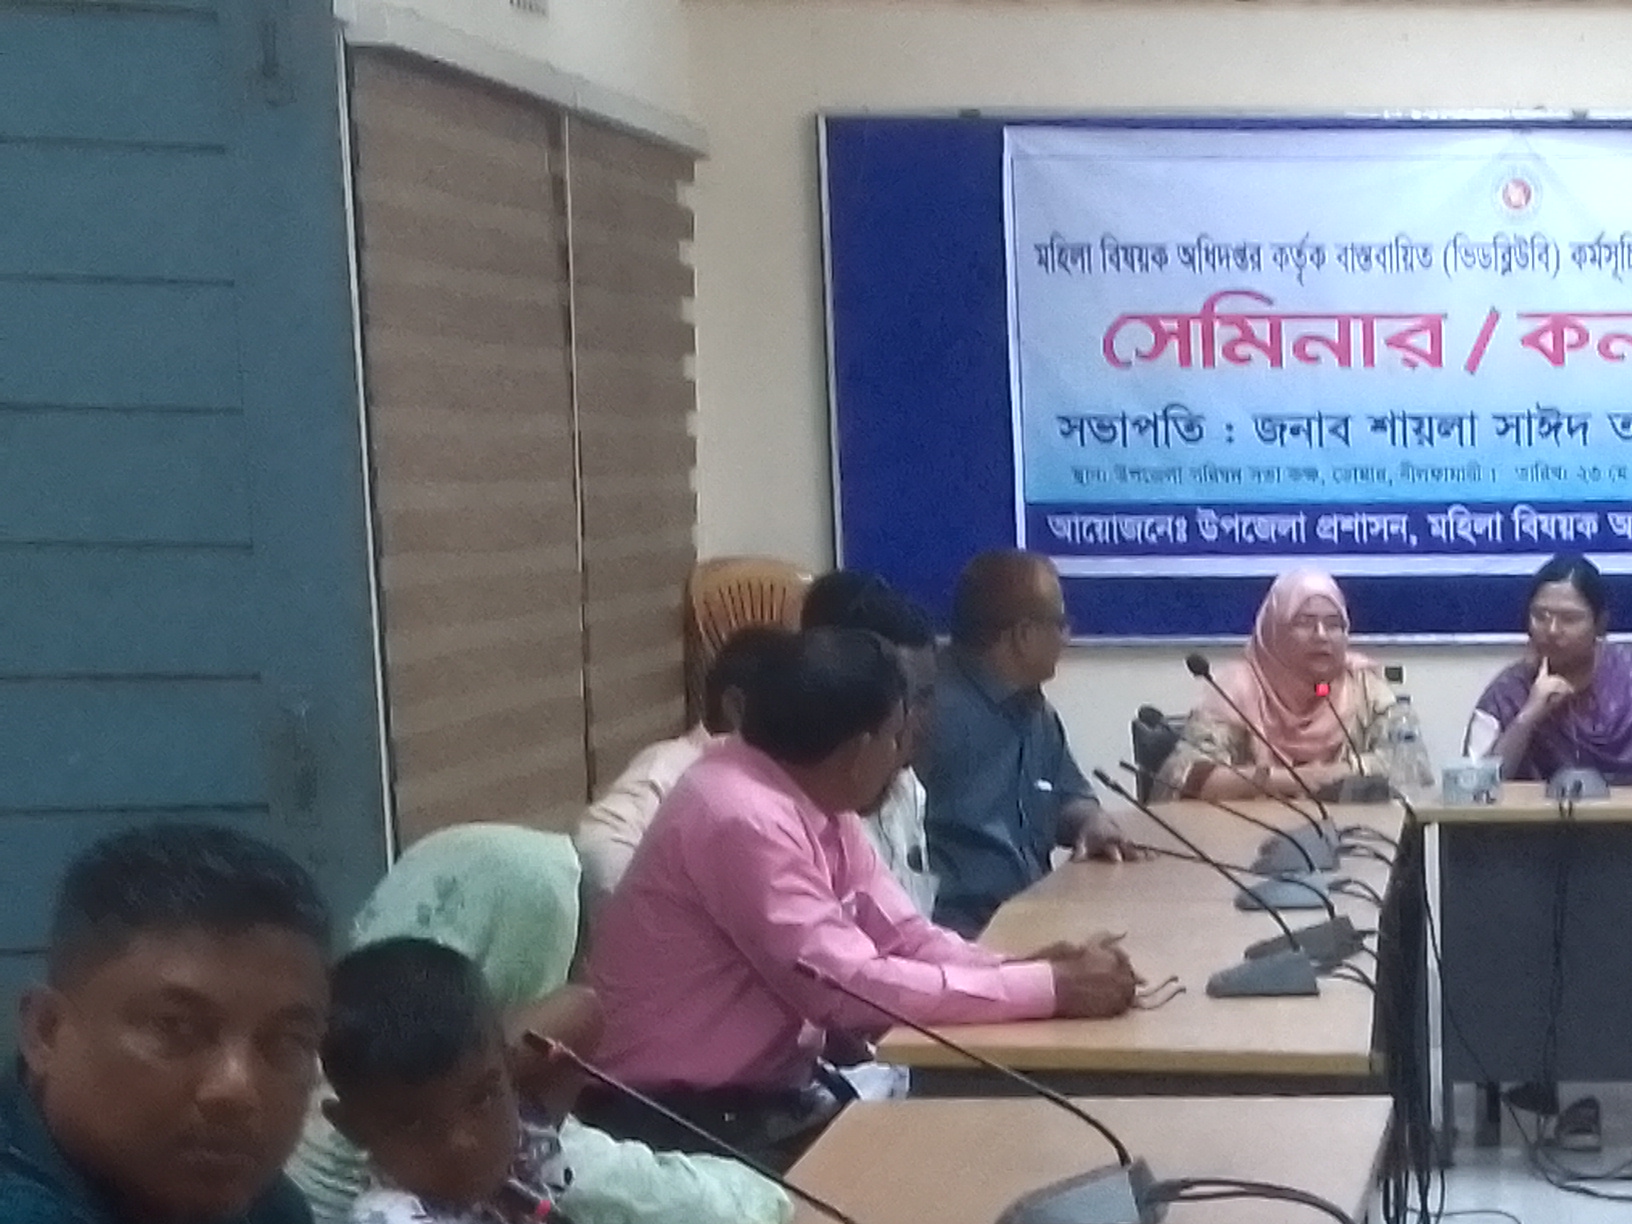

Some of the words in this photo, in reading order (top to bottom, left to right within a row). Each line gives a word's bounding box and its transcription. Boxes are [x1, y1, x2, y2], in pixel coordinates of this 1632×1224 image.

[1034, 230, 1093, 276] মহিলা
[1099, 231, 1170, 274] বিষয়ক
[1177, 231, 1262, 275] অধিদপ্তর
[1269, 230, 1326, 287] কর্তৃক
[1334, 231, 1433, 274] বাস্তবায়িত
[1102, 289, 1449, 369] সেমিনার
[1464, 306, 1502, 375] /
[1057, 403, 1206, 449] সভাপতি
[1251, 409, 1352, 449] জনাব
[1367, 409, 1480, 448] শায়লা
[1492, 402, 1593, 447] সাঈদ
[1048, 512, 1188, 545] আয়োজনেঃ
[1196, 506, 1308, 544] উপজেলা
[1315, 512, 1418, 548] প্রশাসন,
[1427, 504, 1503, 546] মহিলা
[1511, 503, 1599, 543] বিষয়ক
